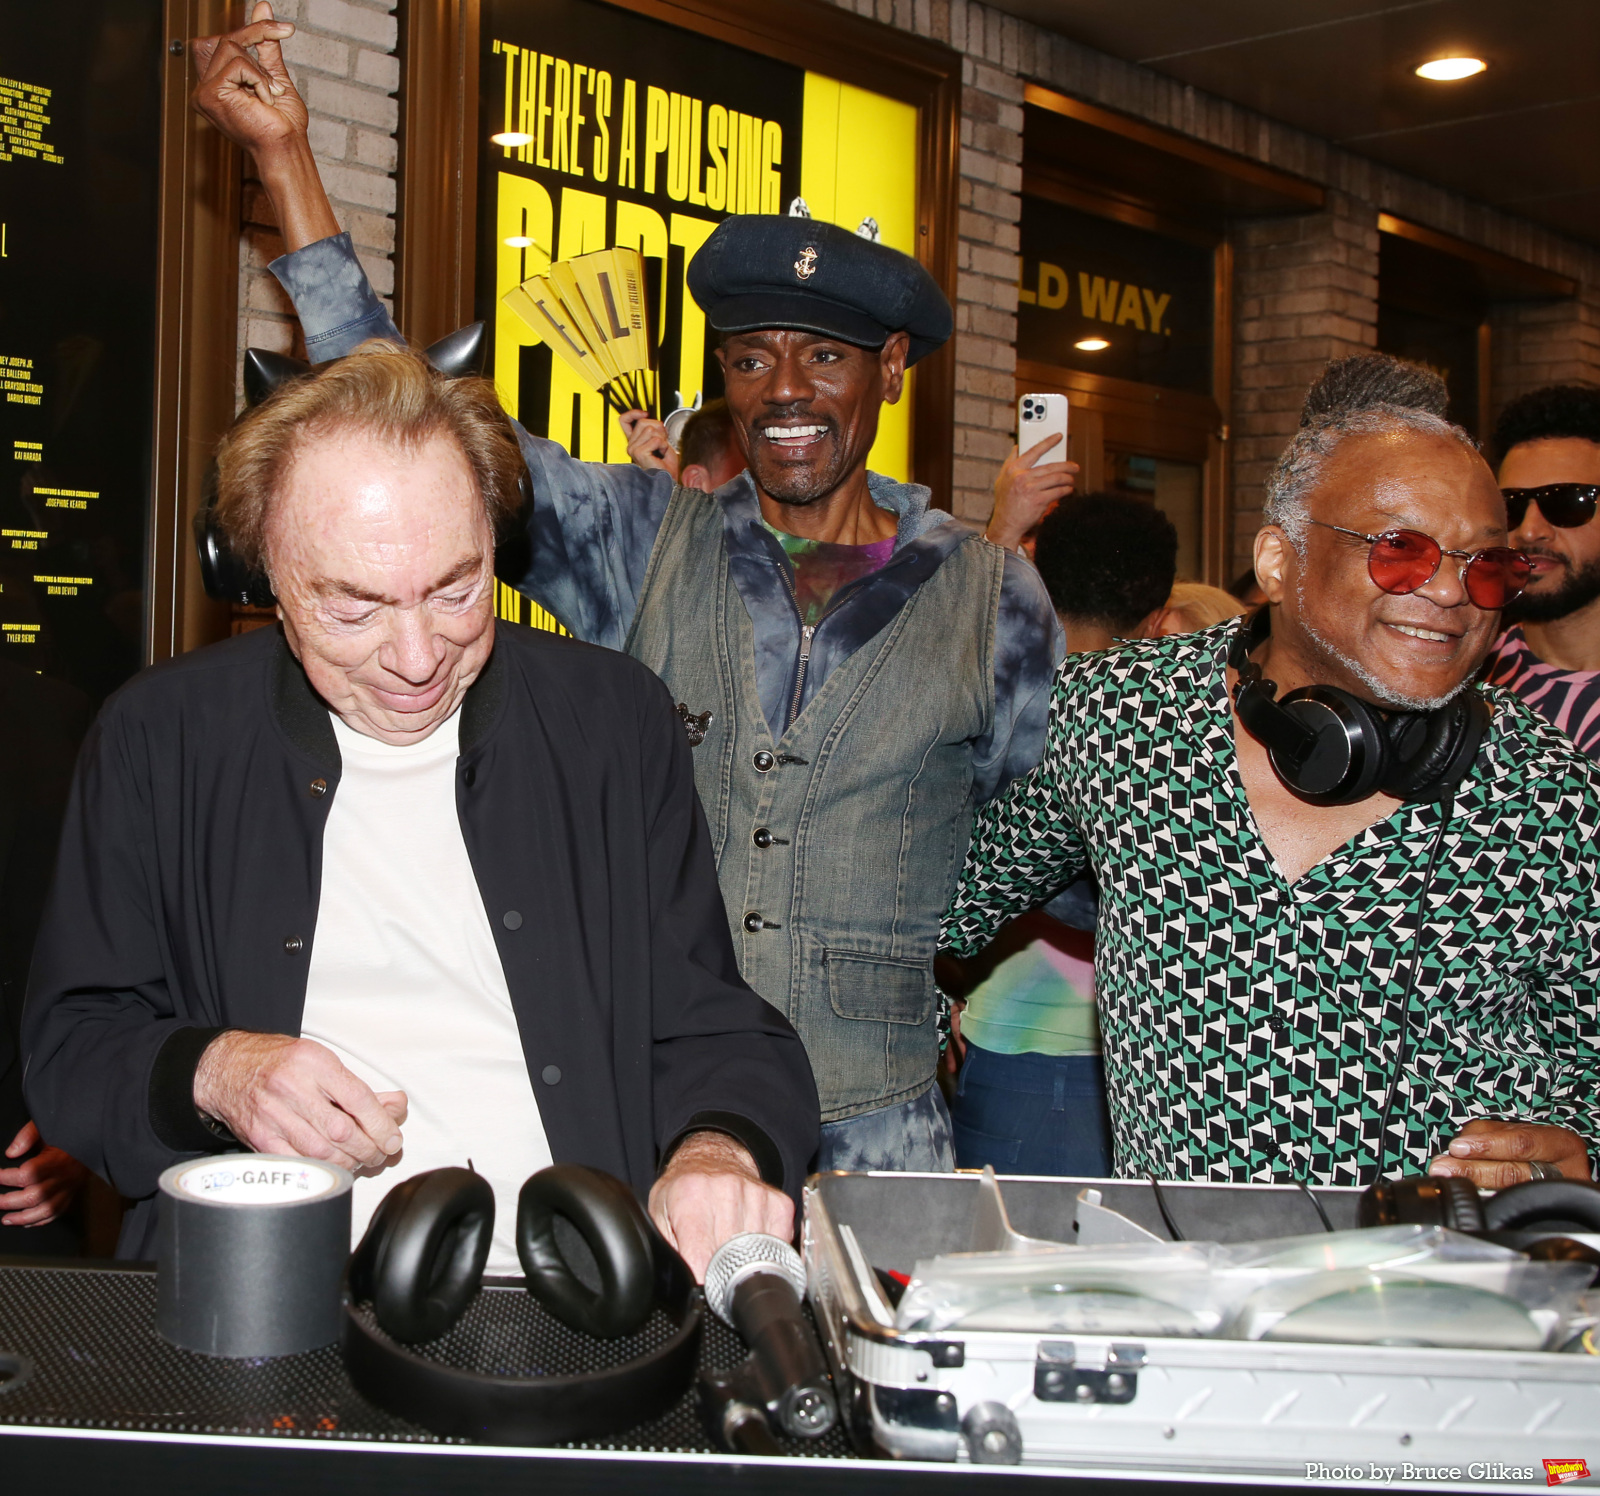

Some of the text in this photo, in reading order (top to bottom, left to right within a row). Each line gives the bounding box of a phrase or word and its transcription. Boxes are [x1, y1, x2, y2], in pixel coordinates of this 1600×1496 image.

[18, 81, 21, 90] &
[26, 111, 50, 124] PRODUCTIONS
[618, 78, 636, 189] A
[644, 85, 783, 215] PULSING
[1078, 271, 1172, 336] WAY.
[631, 313, 641, 329] CATS
[9, 356, 26, 368] JOSEPH
[14, 451, 22, 460] KAI
[46, 498, 69, 508] JOSEPHINE
[26, 531, 48, 539] SPECIALIST
[22, 541, 38, 550] JAMES
[48, 586, 77, 596] BRIAN DEVITO
[7, 633, 21, 643] TYLER
